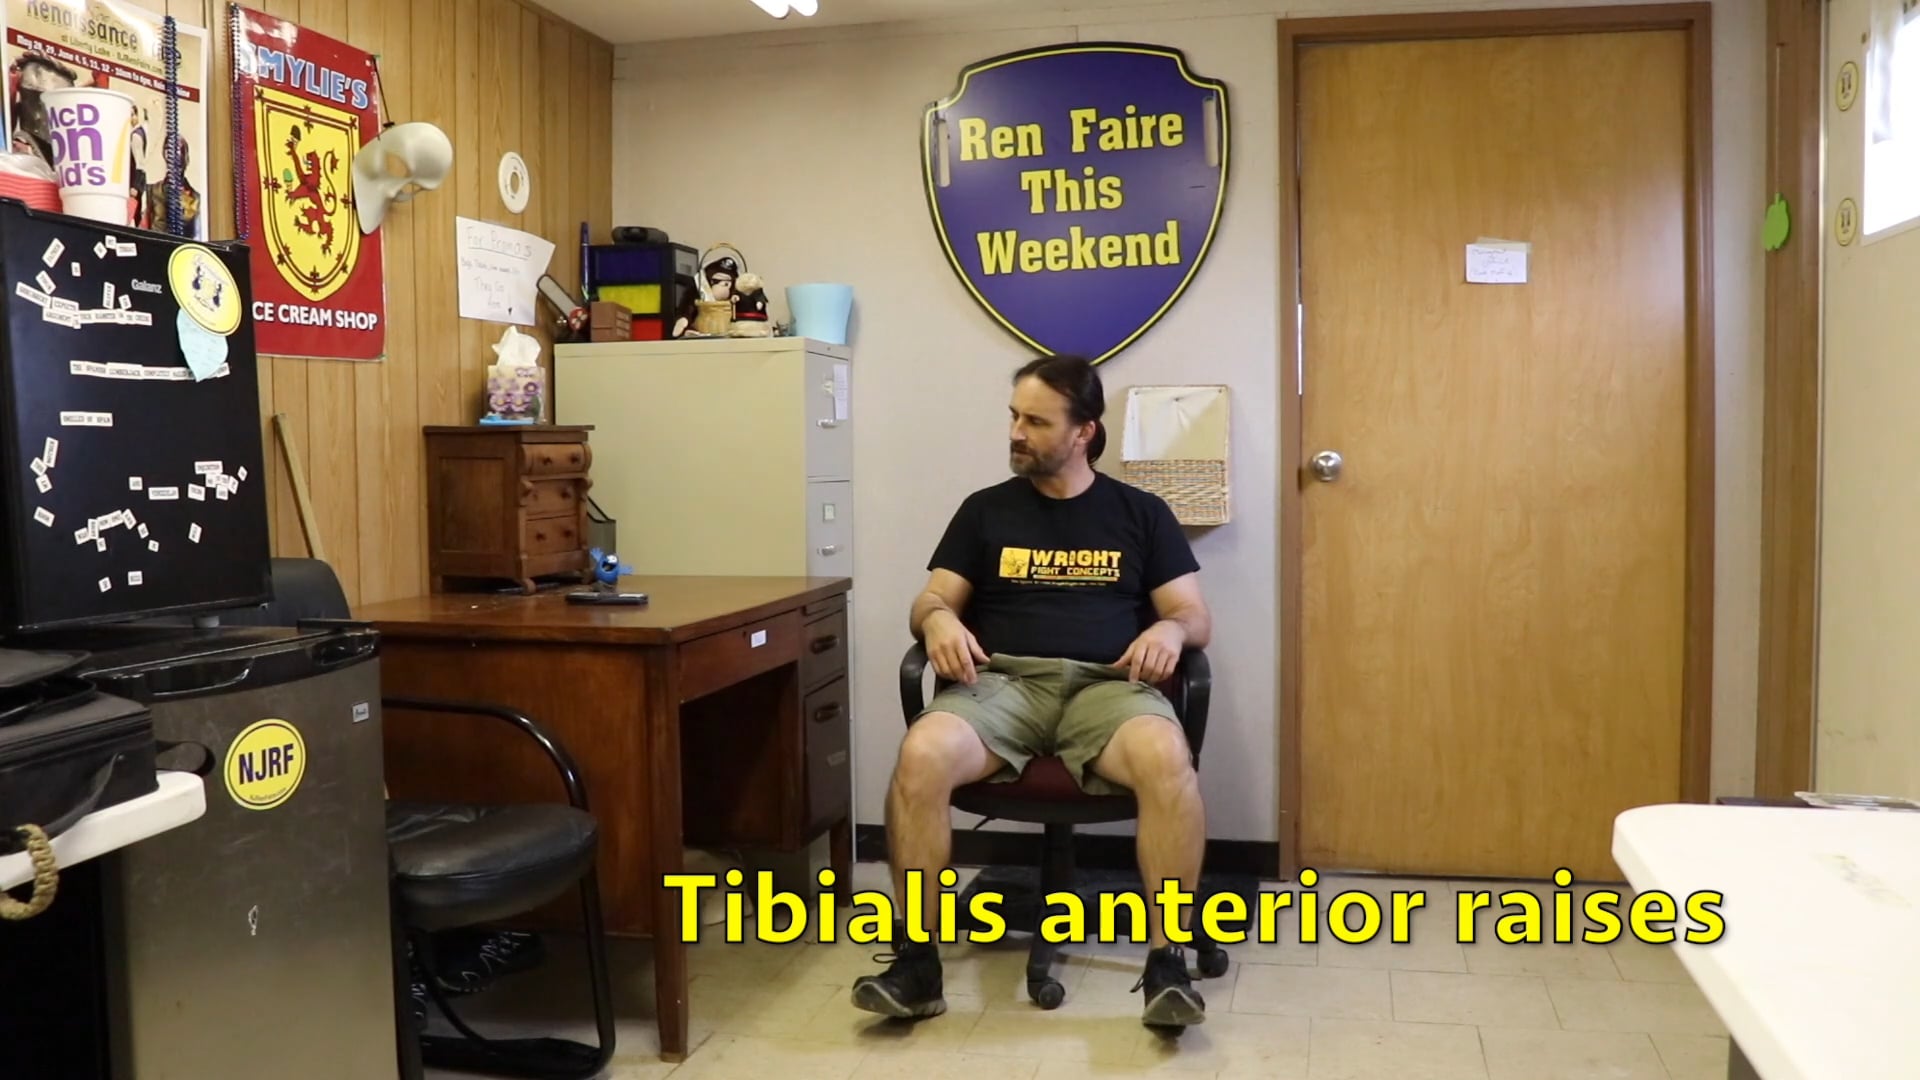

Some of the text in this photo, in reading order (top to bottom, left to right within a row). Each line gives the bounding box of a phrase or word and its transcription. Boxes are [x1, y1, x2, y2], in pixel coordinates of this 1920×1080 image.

[959, 104, 1184, 162] Ren Faire
[1020, 166, 1124, 214] This
[976, 219, 1181, 275] Weekend
[252, 301, 378, 330] CE CREAM SHOP
[1030, 566, 1121, 577] FIGHT CONCEPTS
[1031, 549, 1122, 568] WRIGHT
[238, 743, 294, 785] NJRF
